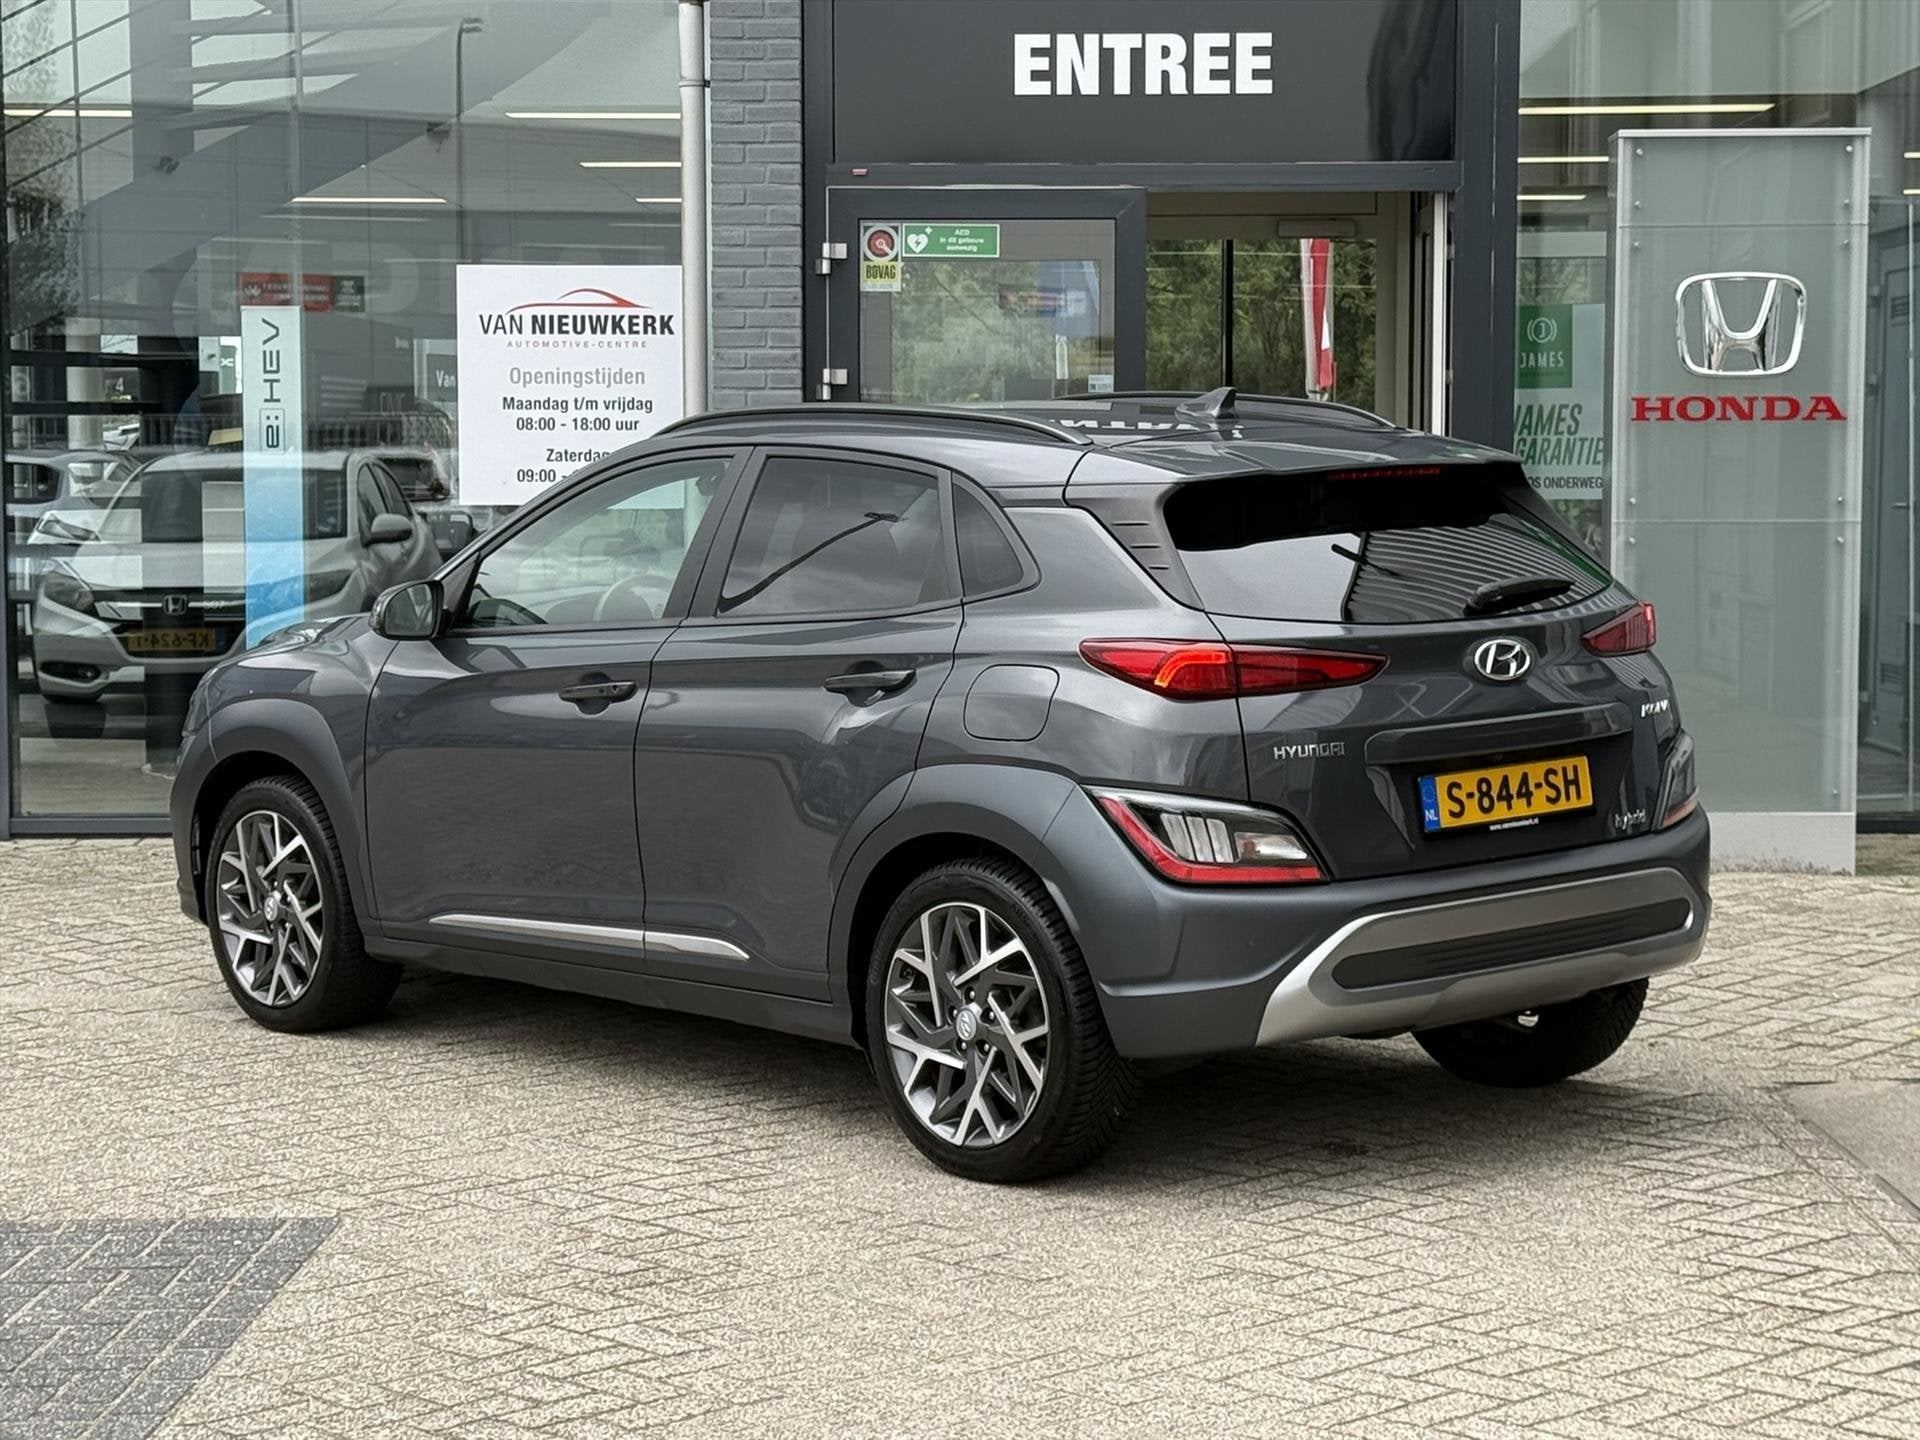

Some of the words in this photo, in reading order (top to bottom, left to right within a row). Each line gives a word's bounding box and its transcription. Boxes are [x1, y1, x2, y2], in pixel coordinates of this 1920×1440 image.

[1013, 32, 1274, 96] ENTREE
[865, 264, 897, 280] BOVAG
[478, 314, 524, 336] VAN
[530, 314, 675, 336] NIEUWKERK
[506, 340, 648, 349] AUTOMOTIVE-CENTRE
[1520, 351, 1565, 369] JAMES
[509, 366, 646, 388] Openingstijden
[502, 396, 569, 413] Maandag
[574, 397, 599, 411] t/m
[603, 397, 653, 413] vrijdag
[1630, 394, 1848, 422] HONDA
[516, 417, 556, 431] 08:00
[572, 417, 611, 431] 18:00
[615, 419, 640, 431] uur
[1515, 437, 1604, 466] GARANTIE
[516, 469, 556, 483] 09:00
[1543, 476, 1604, 489] ONDERWEG
[1273, 742, 1345, 760] HYUNDAI
[1446, 764, 1582, 819] S-844-SH
[1424, 809, 1439, 821] NL
[1615, 808, 1646, 830] hybrid
